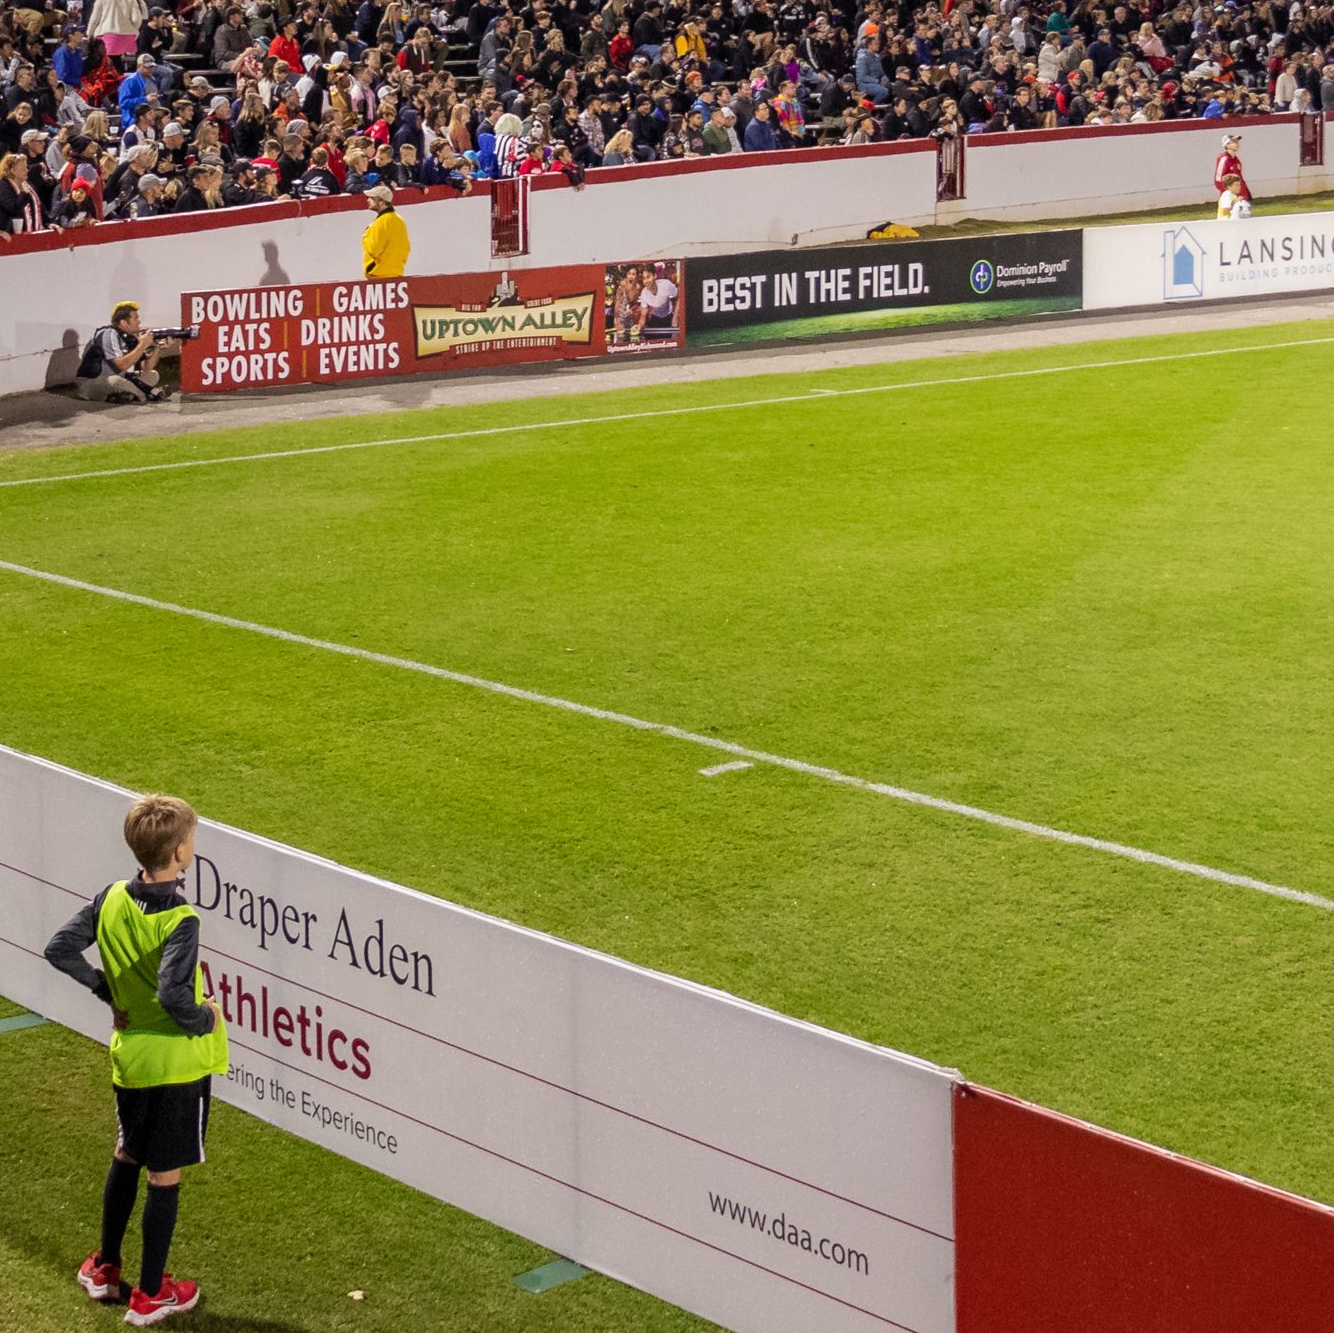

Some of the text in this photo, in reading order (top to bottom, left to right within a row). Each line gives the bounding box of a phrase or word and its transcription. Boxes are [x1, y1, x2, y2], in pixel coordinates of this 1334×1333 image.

[702, 262, 930, 313] BEST IN THE FIELD.
[996, 263, 1038, 277] Dominion
[1219, 268, 1278, 282] BUILDING
[191, 282, 409, 324] BOWLING GAMES
[422, 306, 589, 341] UPTOWN ALLEY
[218, 313, 385, 353] EATS DRINKS
[455, 336, 557, 355] STRIKE UP THE ENTERTAINMENT
[201, 341, 400, 386] SPORTS EVENTS
[193, 853, 437, 997] Draper Aden
[221, 1061, 398, 1154] ering the Experience
[709, 1191, 869, 1277] www.daa.com
